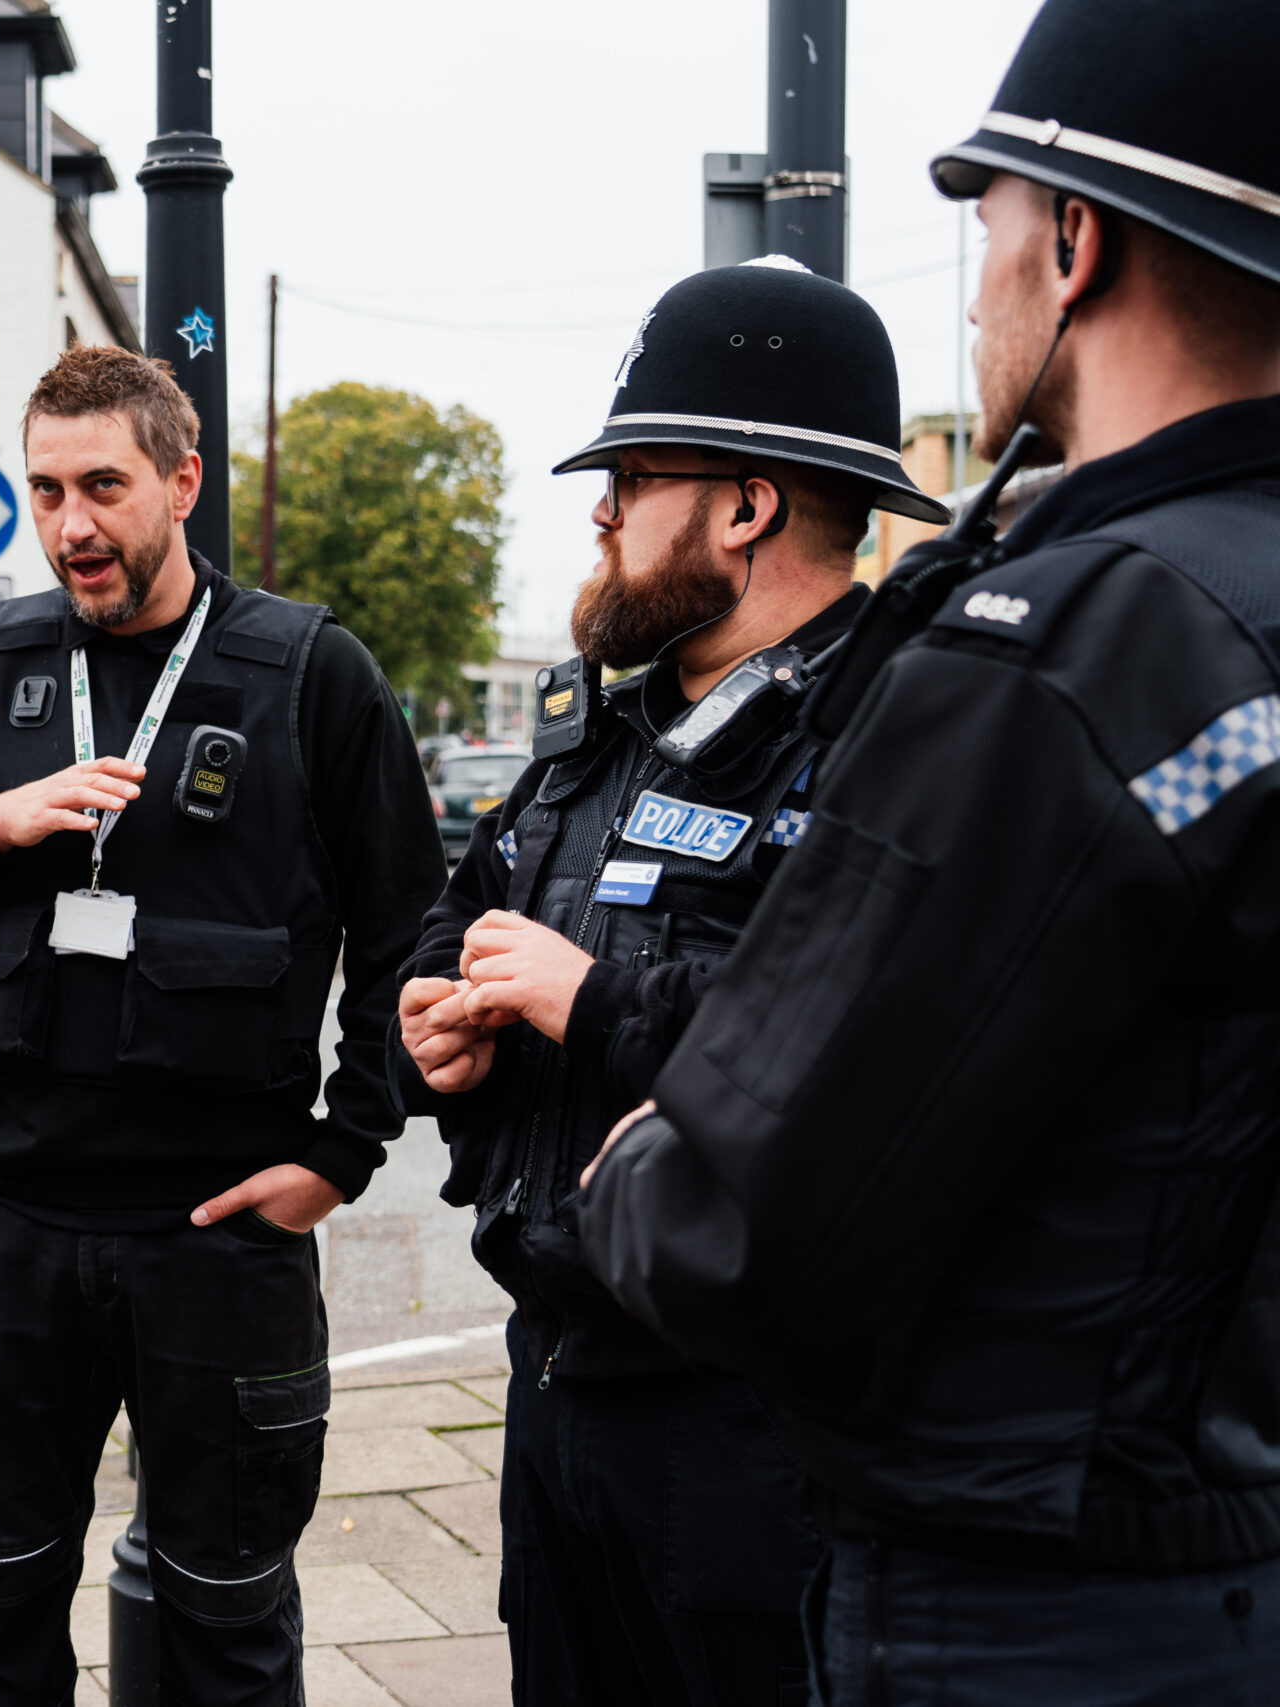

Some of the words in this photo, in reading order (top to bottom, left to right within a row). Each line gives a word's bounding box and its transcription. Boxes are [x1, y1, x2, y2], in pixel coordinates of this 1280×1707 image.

[199, 772, 223, 784] AUDIO
[197, 780, 221, 791] VIDEO
[187, 804, 215, 819] PINNACLE
[633, 800, 738, 852] POLICE
